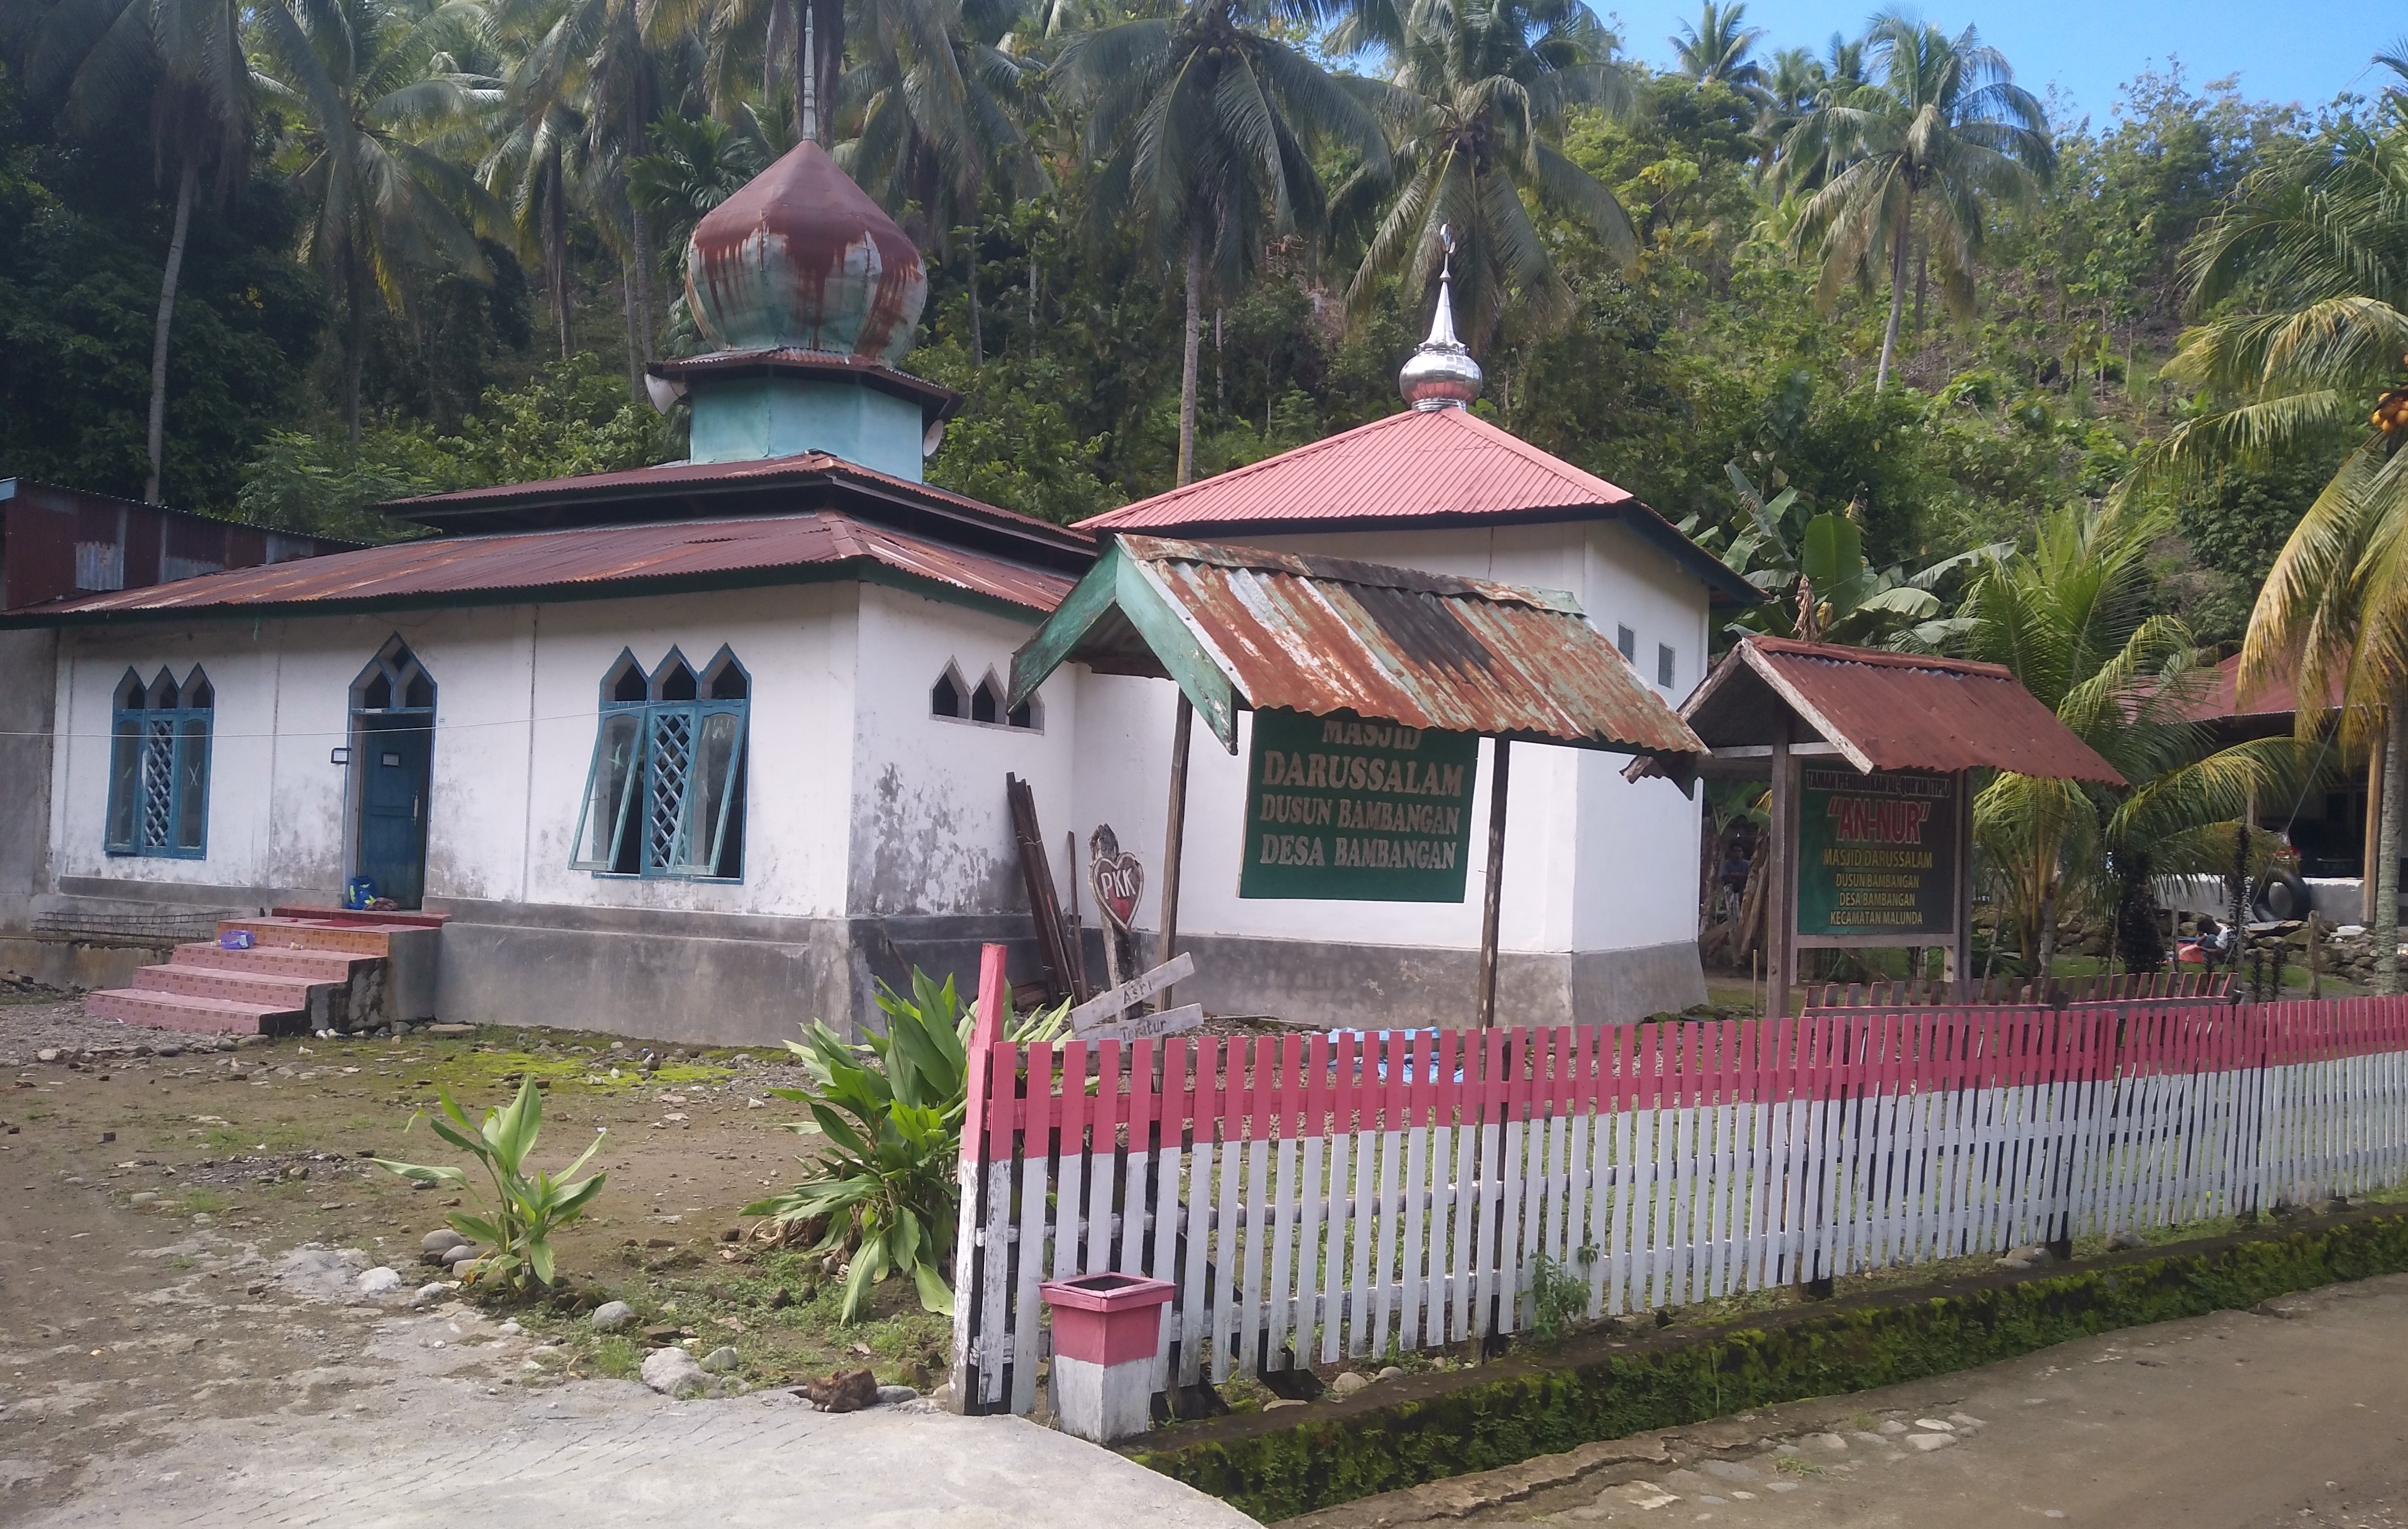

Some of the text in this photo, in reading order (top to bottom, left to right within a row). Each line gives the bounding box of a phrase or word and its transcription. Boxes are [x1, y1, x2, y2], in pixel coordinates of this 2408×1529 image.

[1322, 720, 1422, 749] MASJID
[1262, 751, 1463, 796] DARUSSALAM
[1259, 794, 1460, 835] DUSUN BAMBANGAN
[1259, 834, 1457, 869] DESA BAMBANGAN
[1823, 849, 1932, 868] MASJID DARUSSALAM
[1100, 867, 1136, 900] PKK
[1836, 873, 1919, 888] DUSUN BAMBANGAN
[1839, 892, 1915, 906] DESA BAMBANGAN
[1830, 910, 1922, 925] KECAMATAN MALUNDA
[1119, 1018, 1167, 1042] Teratur
